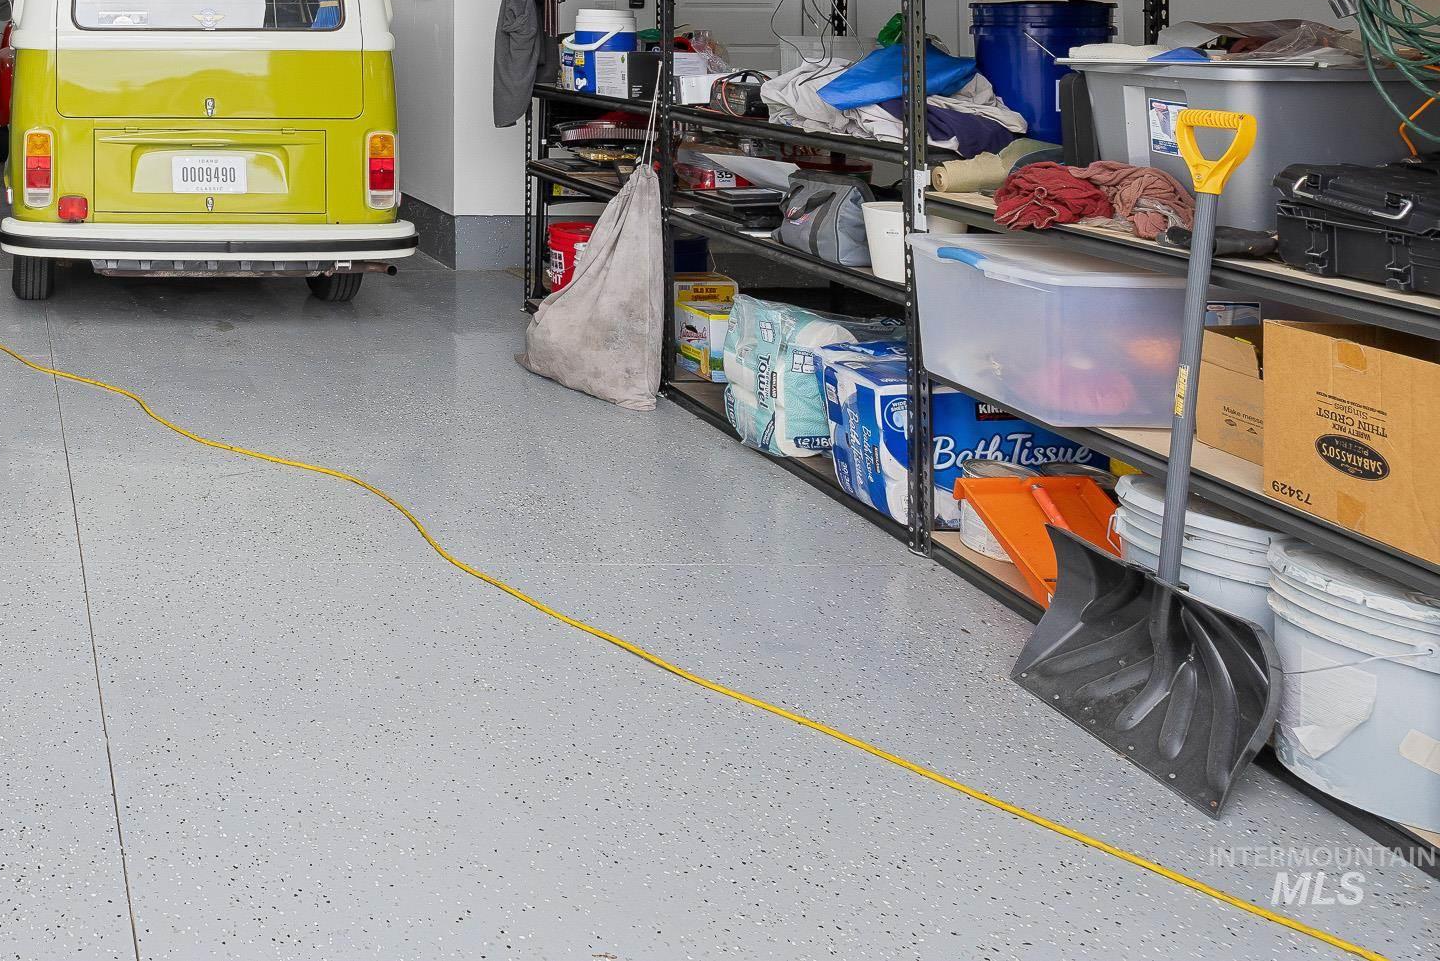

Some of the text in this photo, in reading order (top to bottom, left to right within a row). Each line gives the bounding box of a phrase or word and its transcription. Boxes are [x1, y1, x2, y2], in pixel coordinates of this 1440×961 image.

[182, 167, 236, 182] 0009490
[716, 170, 733, 179] 35
[758, 353, 771, 409] Towel
[1223, 405, 1241, 417] Make
[1334, 403, 1368, 419] Singles
[1316, 407, 1387, 438] THIN CRUST
[1332, 423, 1371, 441] VARIETY PACK
[933, 433, 1093, 470] Bath Tissue
[1321, 443, 1383, 475] SABATASSO'S
[1271, 480, 1312, 505] 73429
